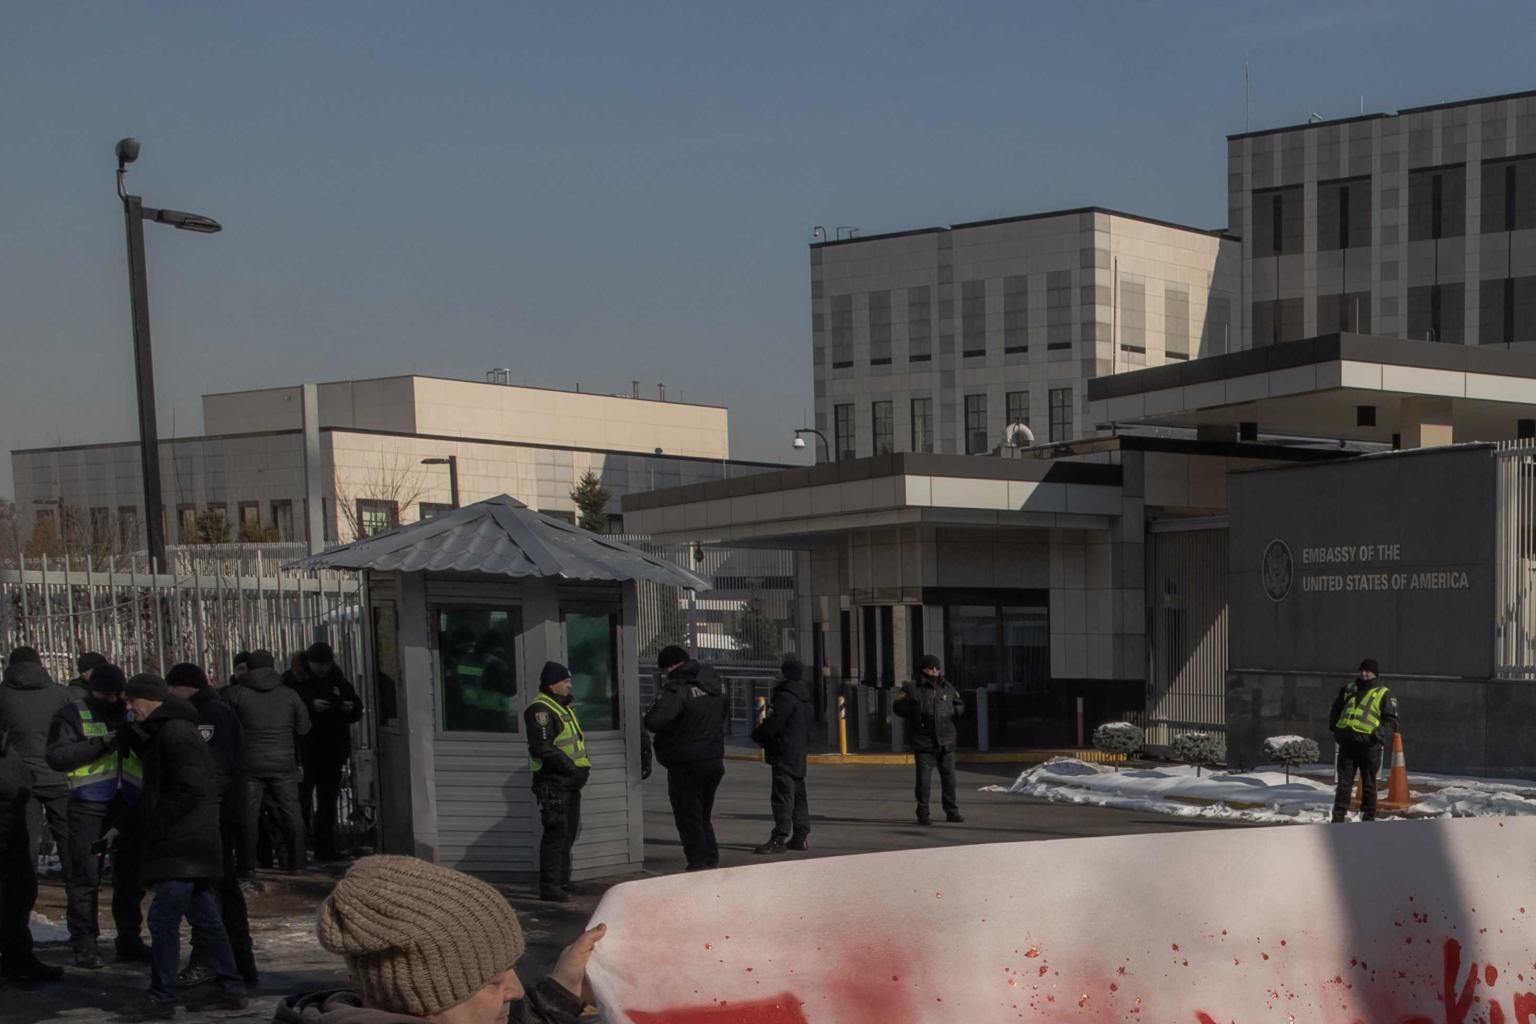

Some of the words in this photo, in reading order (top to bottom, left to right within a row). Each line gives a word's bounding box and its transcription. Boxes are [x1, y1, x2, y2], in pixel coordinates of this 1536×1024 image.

[1303, 545, 1357, 564] EMBASSY
[1359, 545, 1375, 562] OF
[1377, 544, 1401, 561] THE
[1303, 575, 1343, 591] UNITED
[1346, 574, 1389, 590] STATES
[1391, 573, 1408, 590] OF
[1410, 572, 1470, 589] AMERICA
